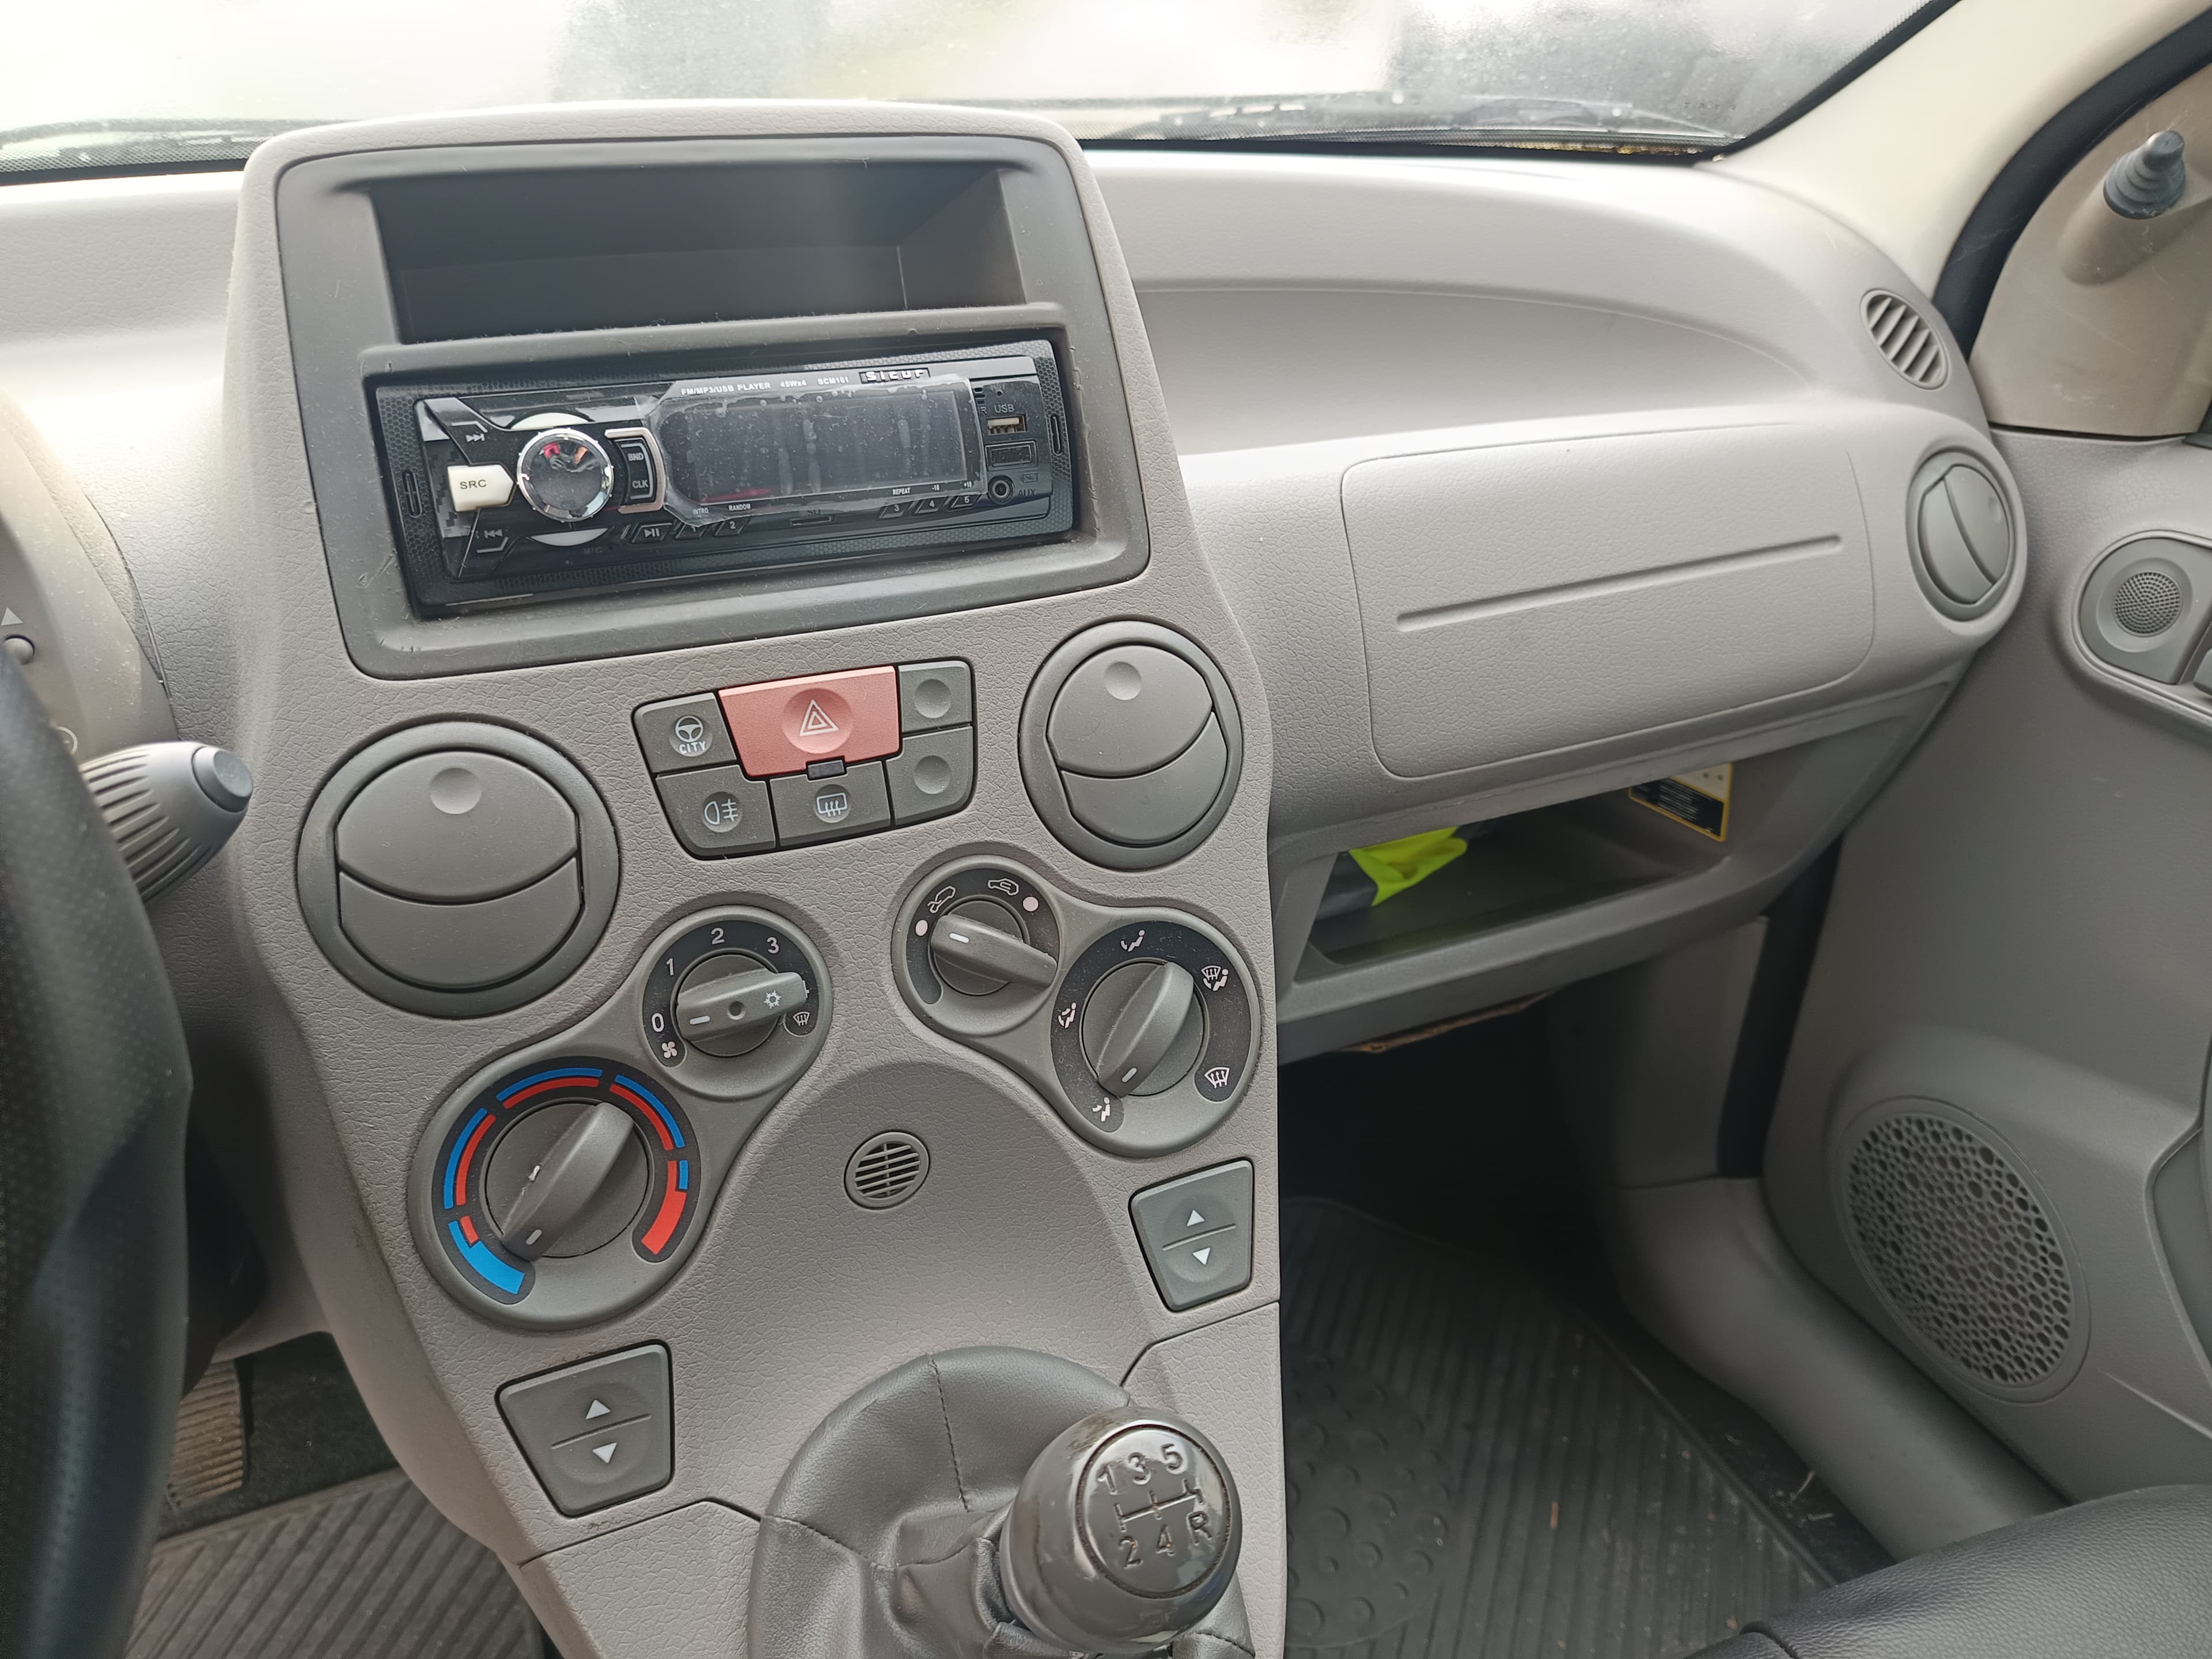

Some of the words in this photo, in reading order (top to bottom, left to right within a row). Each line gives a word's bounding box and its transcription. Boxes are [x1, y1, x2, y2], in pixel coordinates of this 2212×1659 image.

[681, 385, 734, 395] FM/MP3/USB
[737, 382, 771, 392] PLAYER
[993, 403, 1015, 414] USB
[627, 452, 644, 461] BND
[460, 479, 487, 490] SRC
[632, 479, 649, 488] CLK
[892, 487, 911, 495] REPEAT
[728, 503, 751, 512] RANDOM
[893, 504, 900, 512] 3
[729, 520, 737, 529] 2
[679, 740, 706, 754] CITY
[710, 927, 725, 945] 2
[767, 937, 779, 954] 3
[666, 958, 674, 976] 1
[652, 1013, 664, 1032] 0
[1097, 1464, 1118, 1495] 1
[1127, 1452, 1151, 1484] 3
[1161, 1442, 1183, 1472] 5
[1119, 1536, 1144, 1568] 2
[1155, 1524, 1175, 1556] 4
[1187, 1510, 1213, 1546] R
